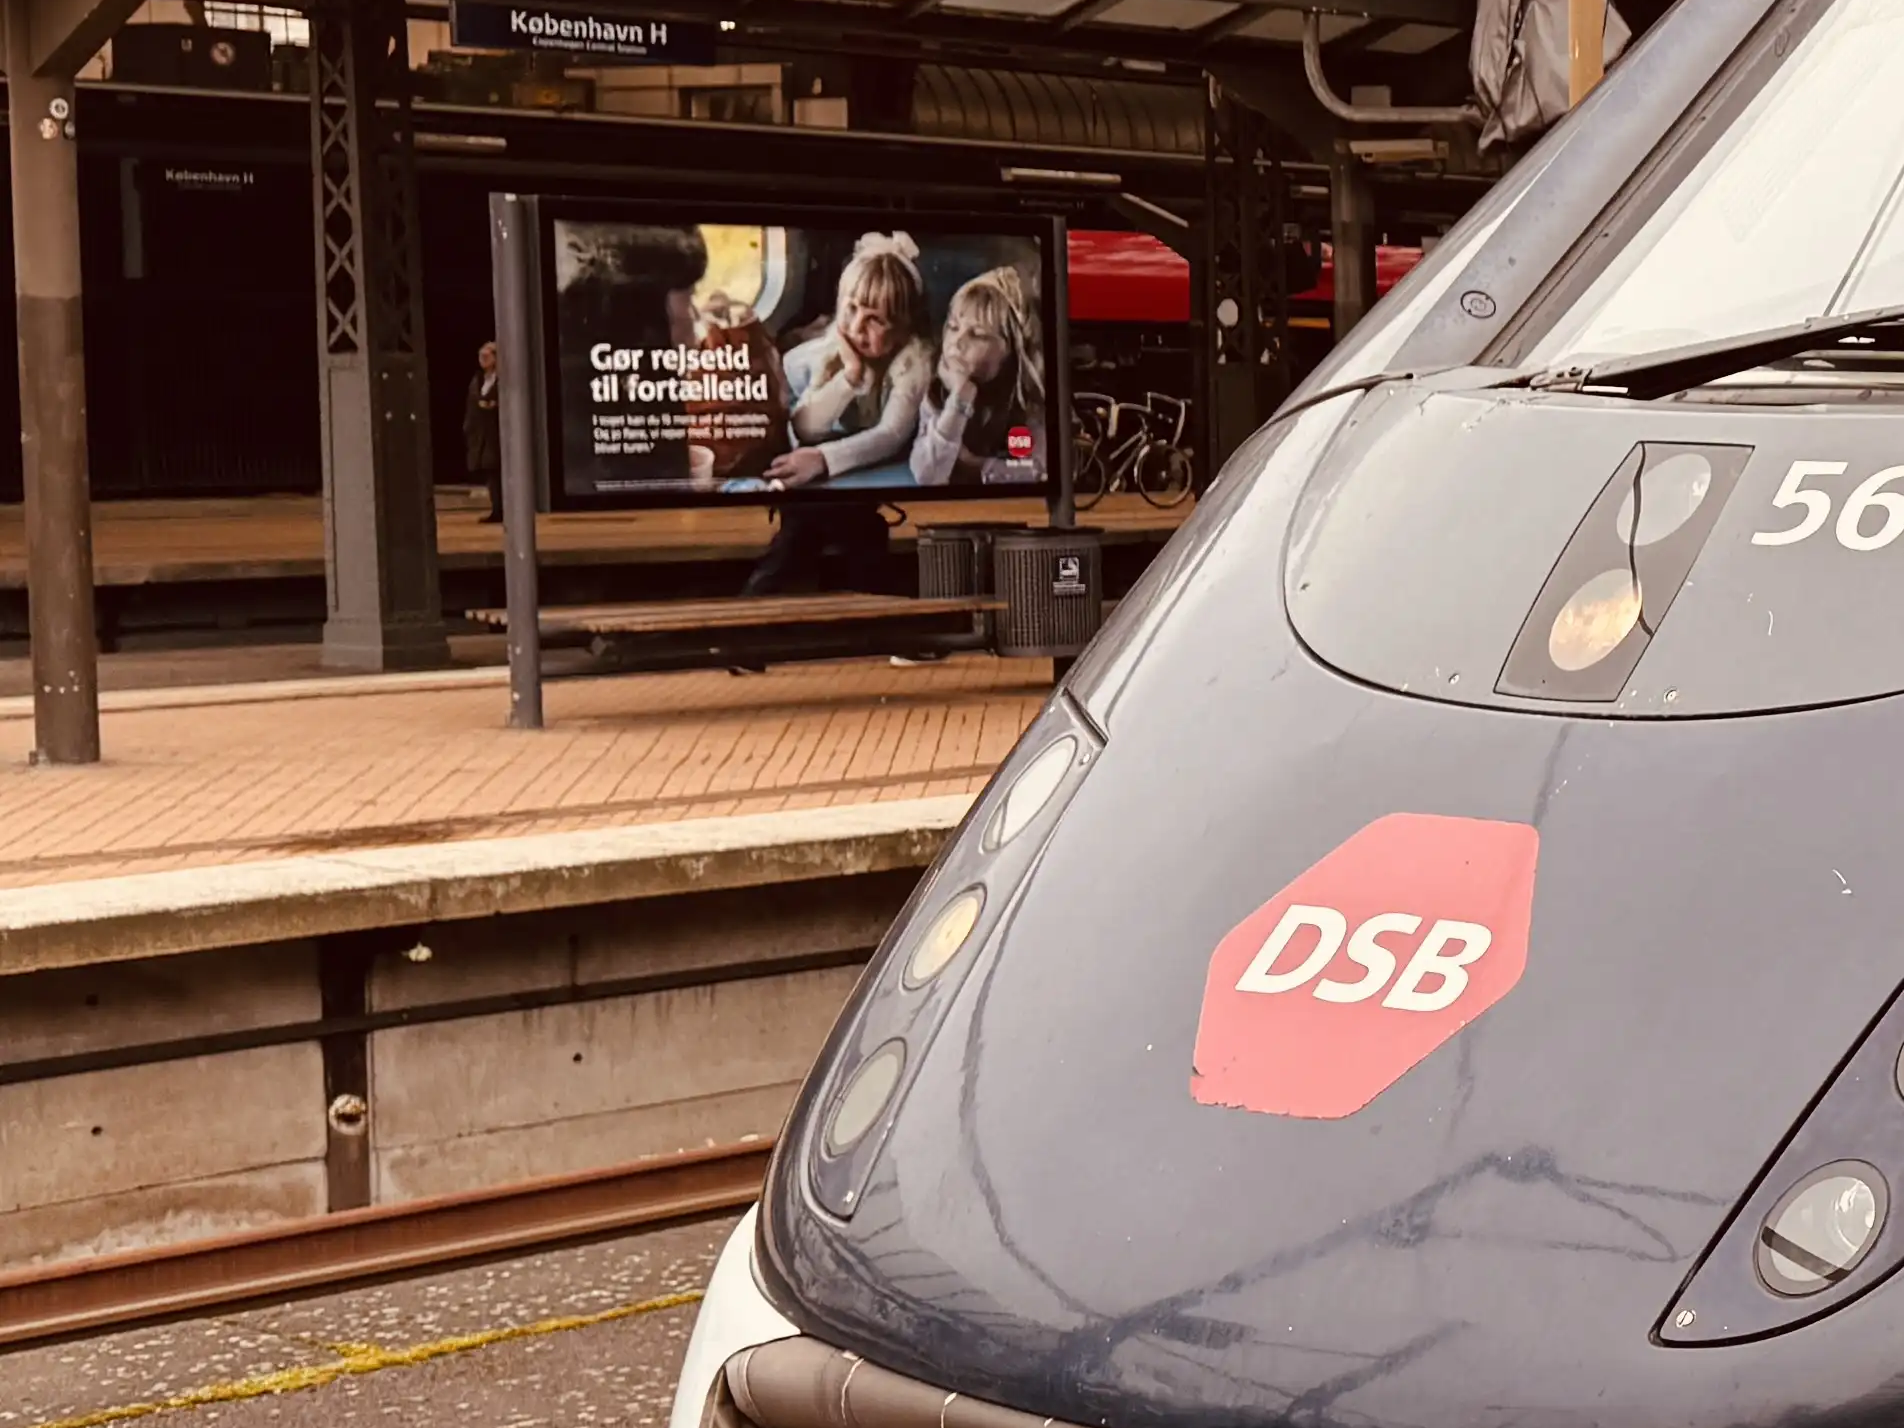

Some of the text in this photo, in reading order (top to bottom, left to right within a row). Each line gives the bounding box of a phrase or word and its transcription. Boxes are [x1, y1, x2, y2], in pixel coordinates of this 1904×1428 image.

[511, 10, 667, 46] København H
[590, 342, 750, 376] Gør rejsetid
[590, 374, 768, 402] til fortælletid
[1235, 903, 1493, 1013] DSB
